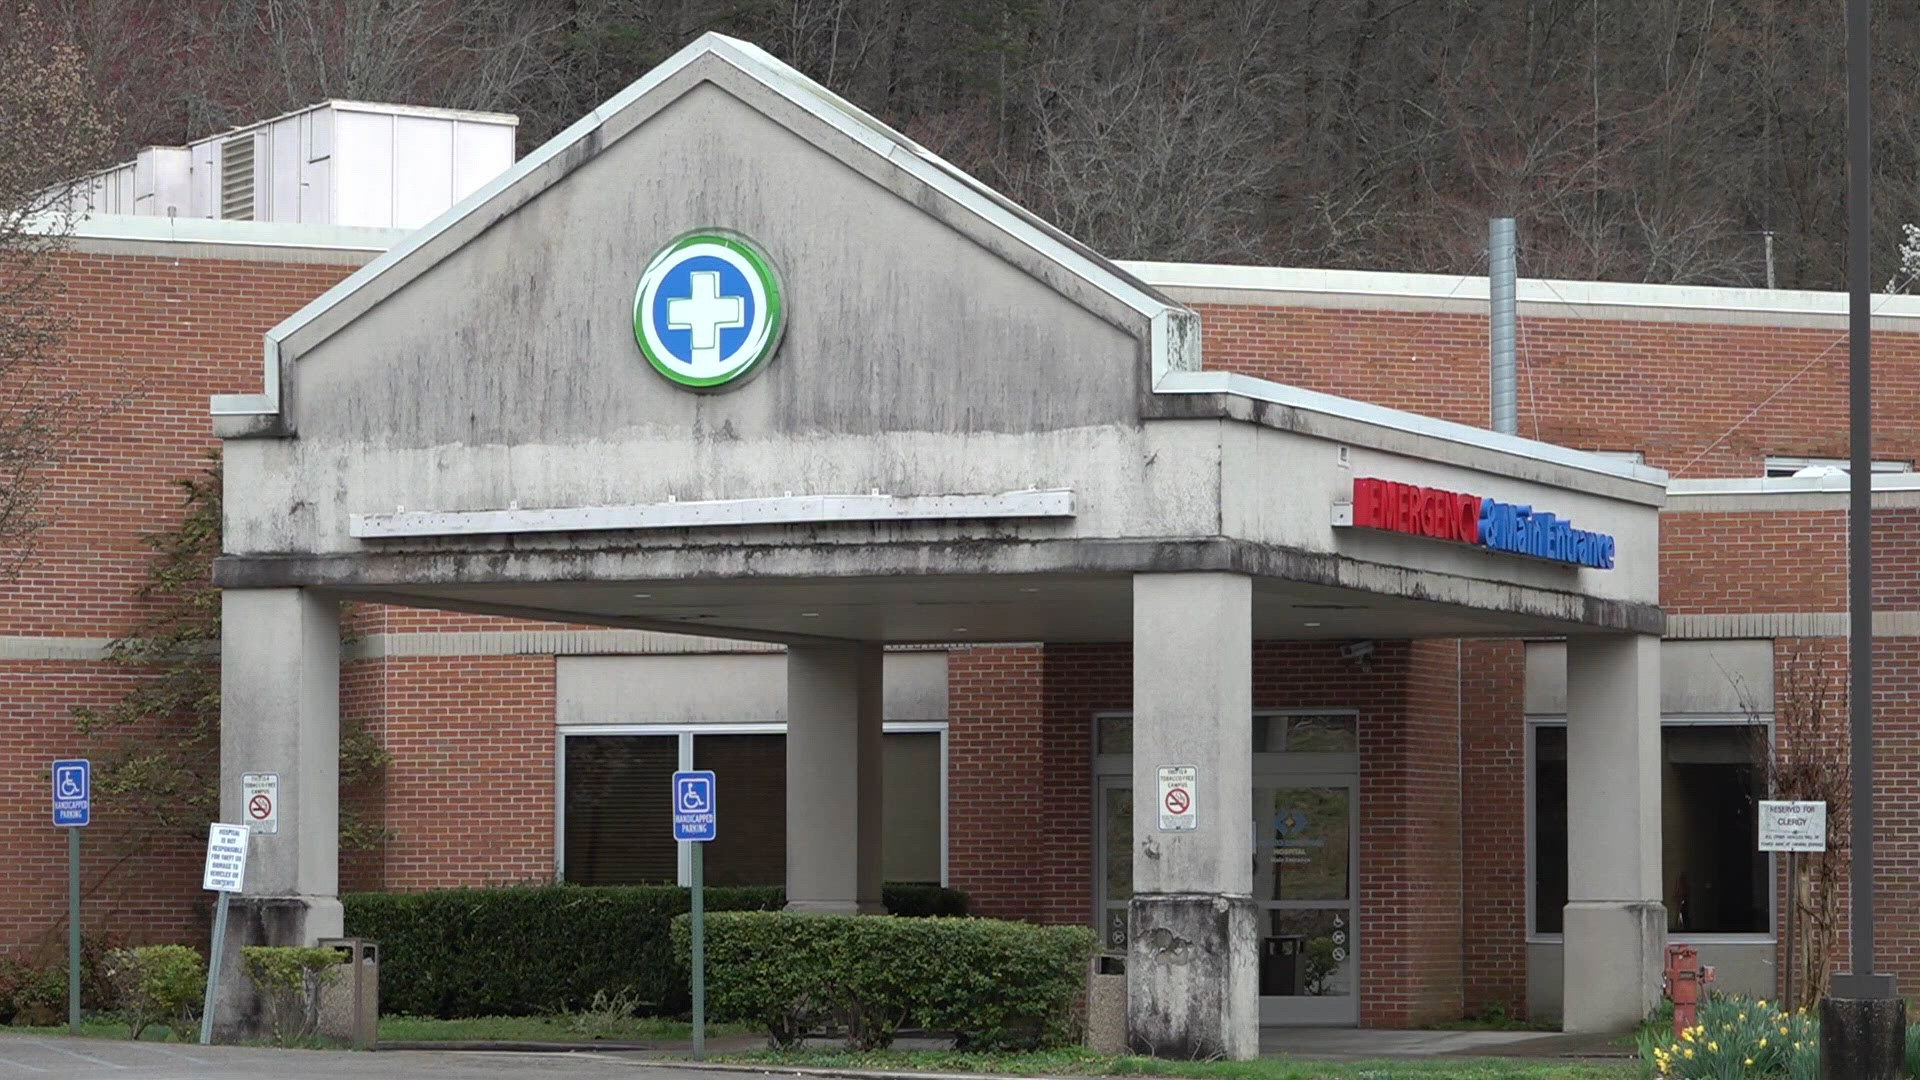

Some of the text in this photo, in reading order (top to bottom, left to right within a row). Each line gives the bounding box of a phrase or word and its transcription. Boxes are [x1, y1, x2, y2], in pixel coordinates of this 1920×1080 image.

[1353, 477, 1615, 569] EMERGENCY & Main Entrance
[55, 801, 88, 809] HANDICAPPED
[1769, 805, 1816, 813] RESERVED FOR
[60, 810, 82, 819] PARKING
[675, 814, 713, 823] HANDICAPPED
[1777, 818, 1808, 826] CLERGY
[681, 823, 707, 833] PARKING
